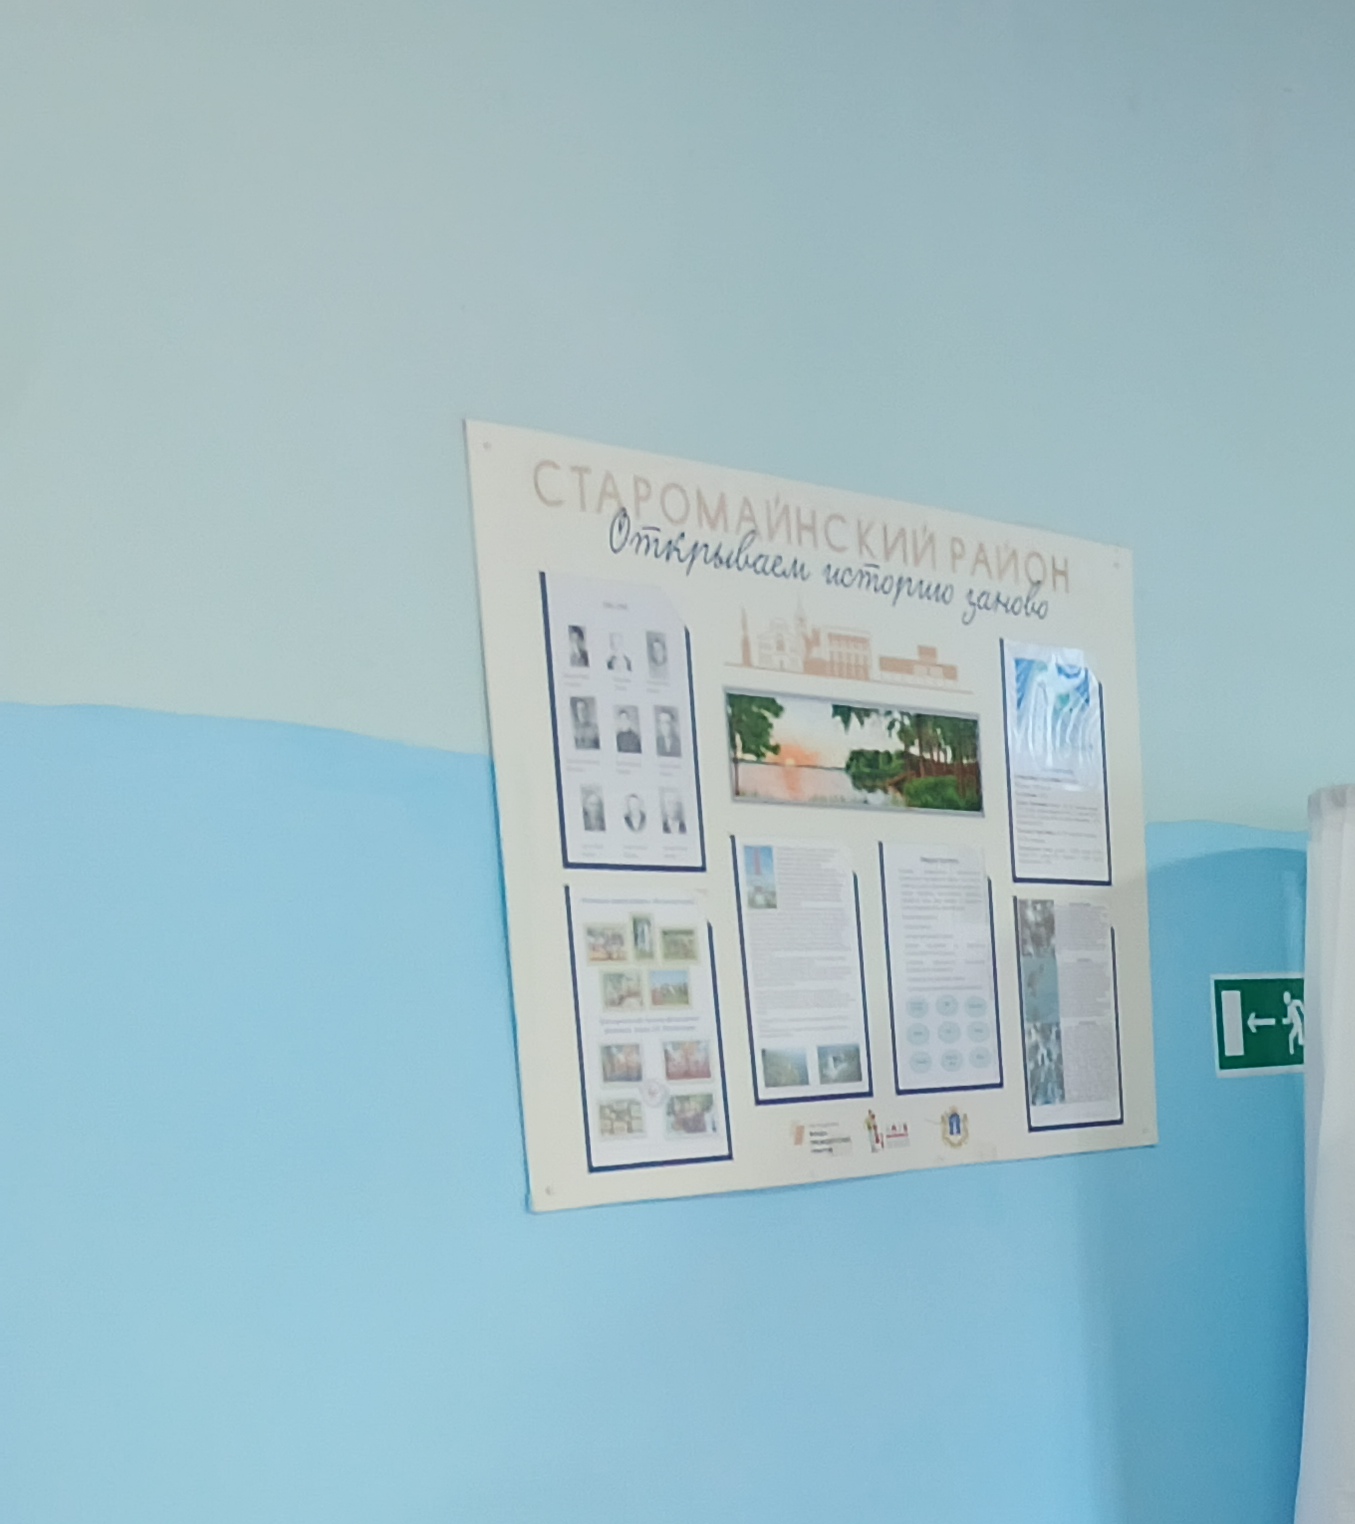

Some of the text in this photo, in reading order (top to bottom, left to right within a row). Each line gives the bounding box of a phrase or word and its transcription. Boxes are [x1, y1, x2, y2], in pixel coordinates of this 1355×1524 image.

[533, 459, 1069, 594] СТАРОМАЙНСКИЙ РАЙОН
[609, 507, 1048, 625] Открываем историю заново
